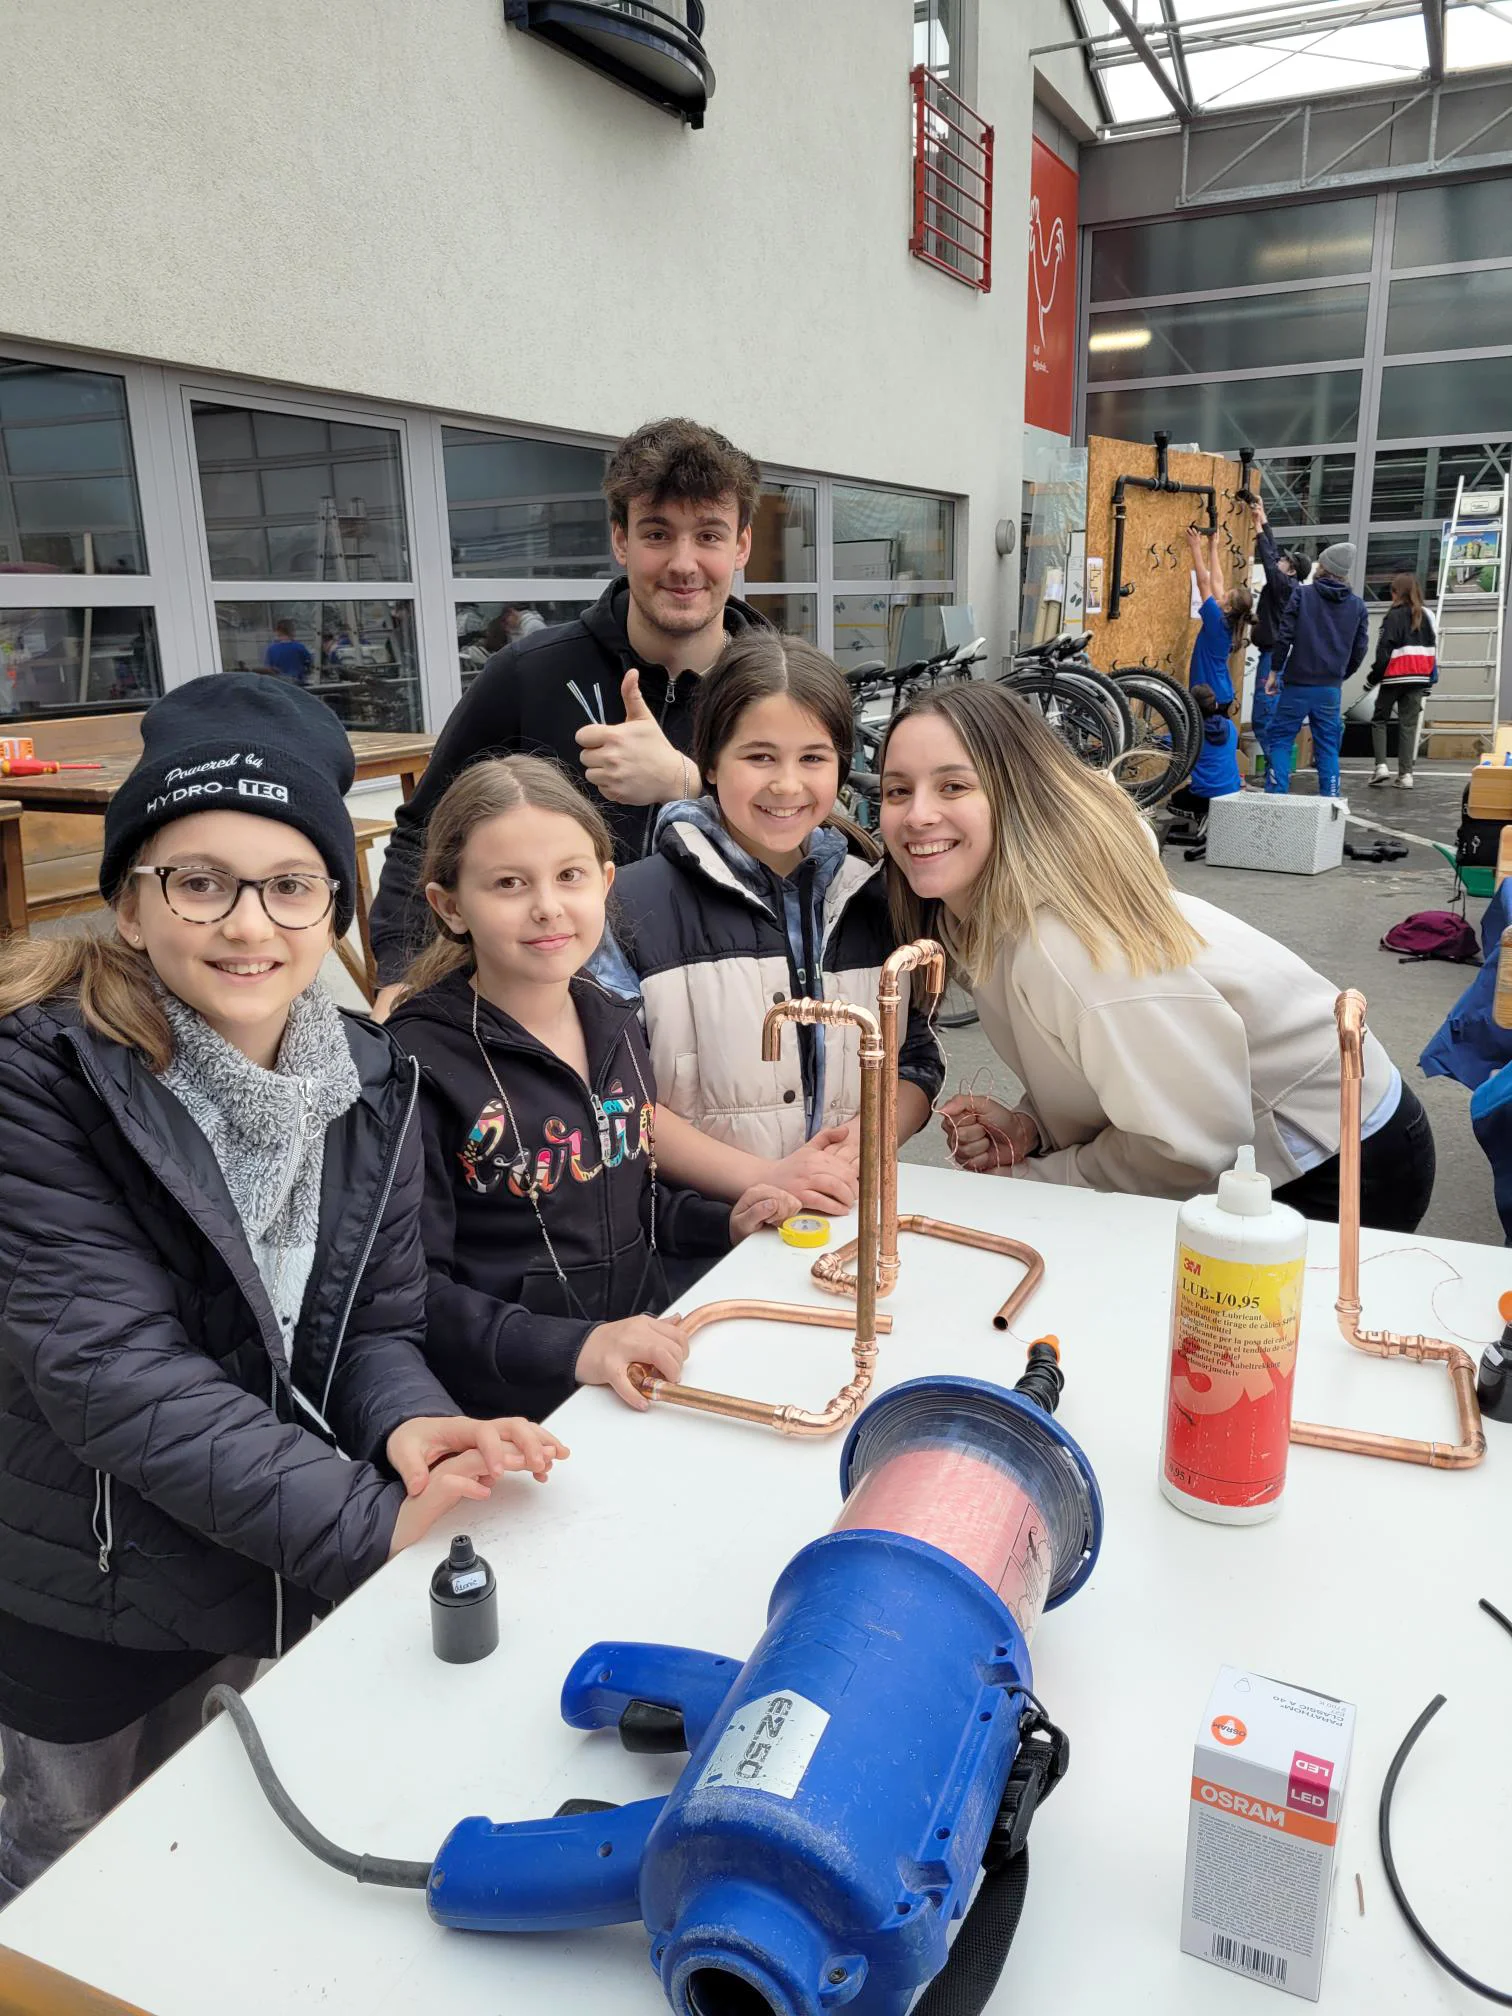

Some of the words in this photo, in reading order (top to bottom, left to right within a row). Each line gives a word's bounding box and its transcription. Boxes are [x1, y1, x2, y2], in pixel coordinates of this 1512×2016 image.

[165, 753, 241, 788] Powered
[245, 753, 265, 769] by
[1184, 1258, 1202, 1276] 3M
[1195, 1301, 1220, 1317] Pulling
[1222, 1310, 1262, 1321] Lubricant
[1212, 1316, 1222, 1324] de
[1223, 1319, 1246, 1329] tirage
[1249, 1320, 1258, 1329] de
[1219, 1335, 1232, 1343] per
[1234, 1336, 1242, 1344] la
[1299, 1703, 1344, 1722] CLASSIC
[1212, 1721, 1247, 1737] OSRAM
[1295, 1759, 1330, 1777] LED
[1200, 1785, 1285, 1827] OSRAM
[1290, 1788, 1325, 1807] LED
